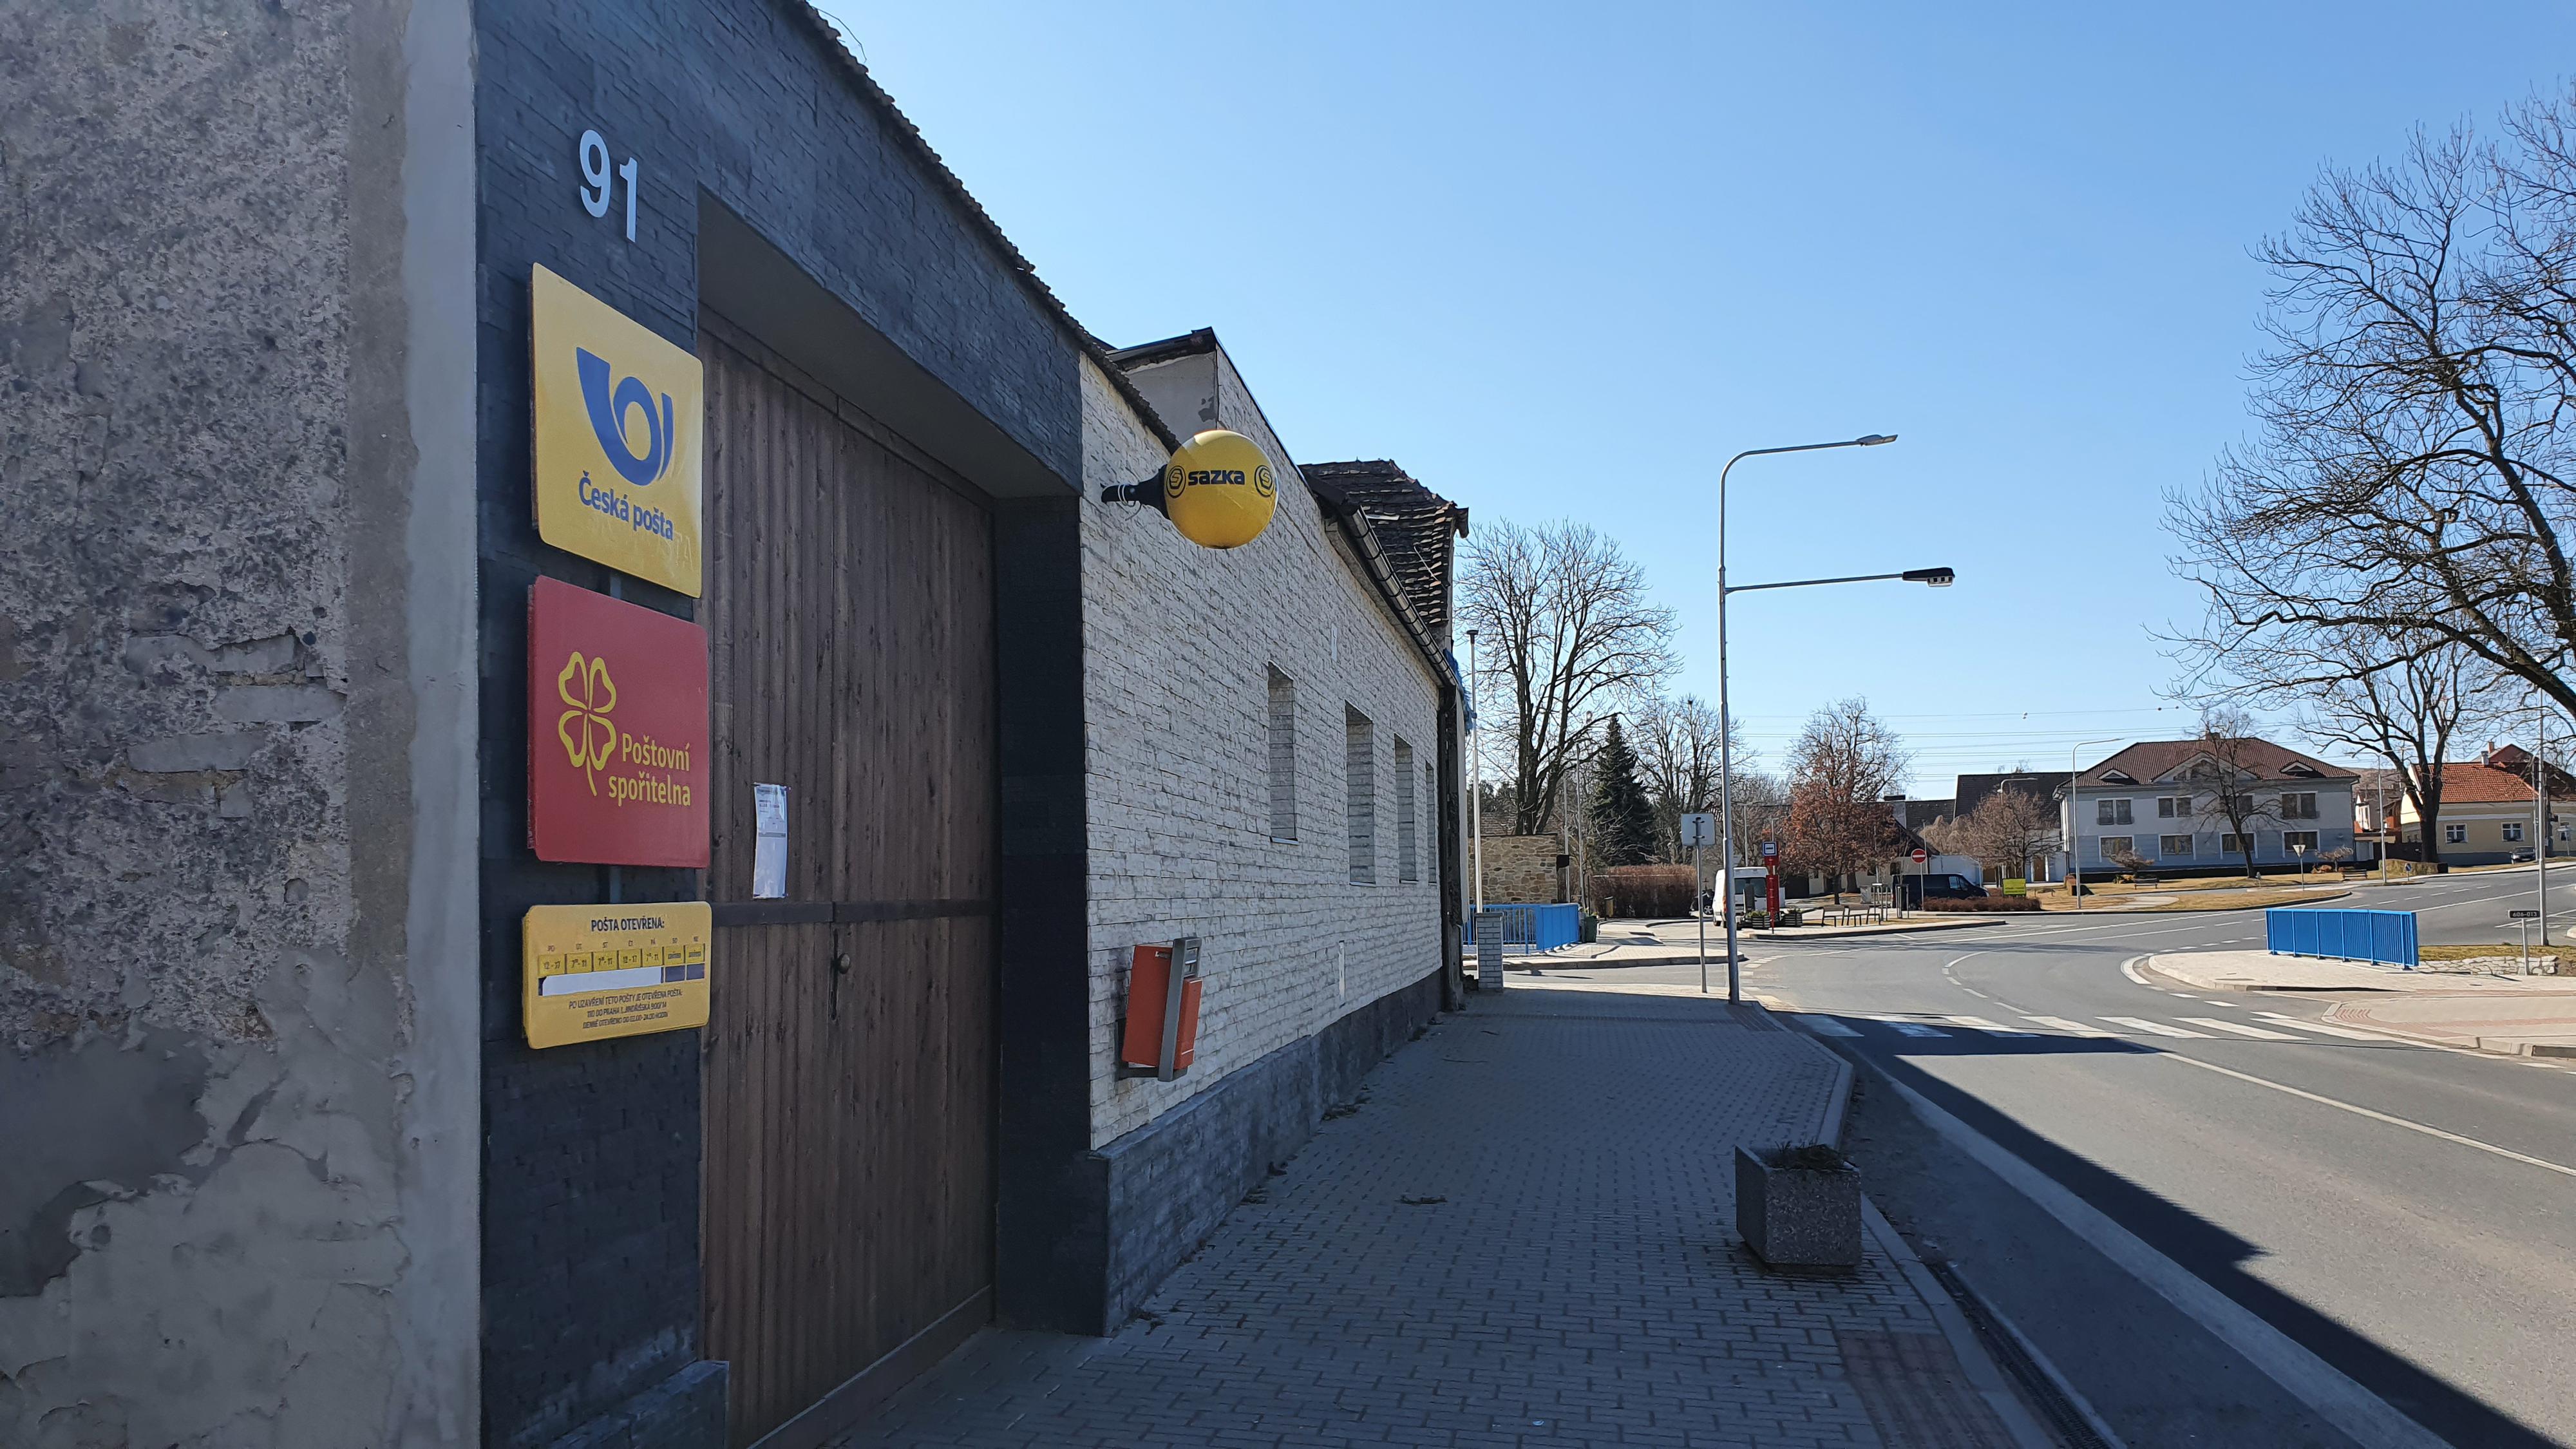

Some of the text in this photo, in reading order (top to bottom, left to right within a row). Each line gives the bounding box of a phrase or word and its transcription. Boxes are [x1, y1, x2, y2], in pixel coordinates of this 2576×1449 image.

[580, 129, 638, 243] 91
[579, 470, 673, 541] Česká pošta
[622, 733, 690, 772] Poštovní
[609, 771, 690, 806] spořitelna
[591, 916, 619, 932] POŠTA
